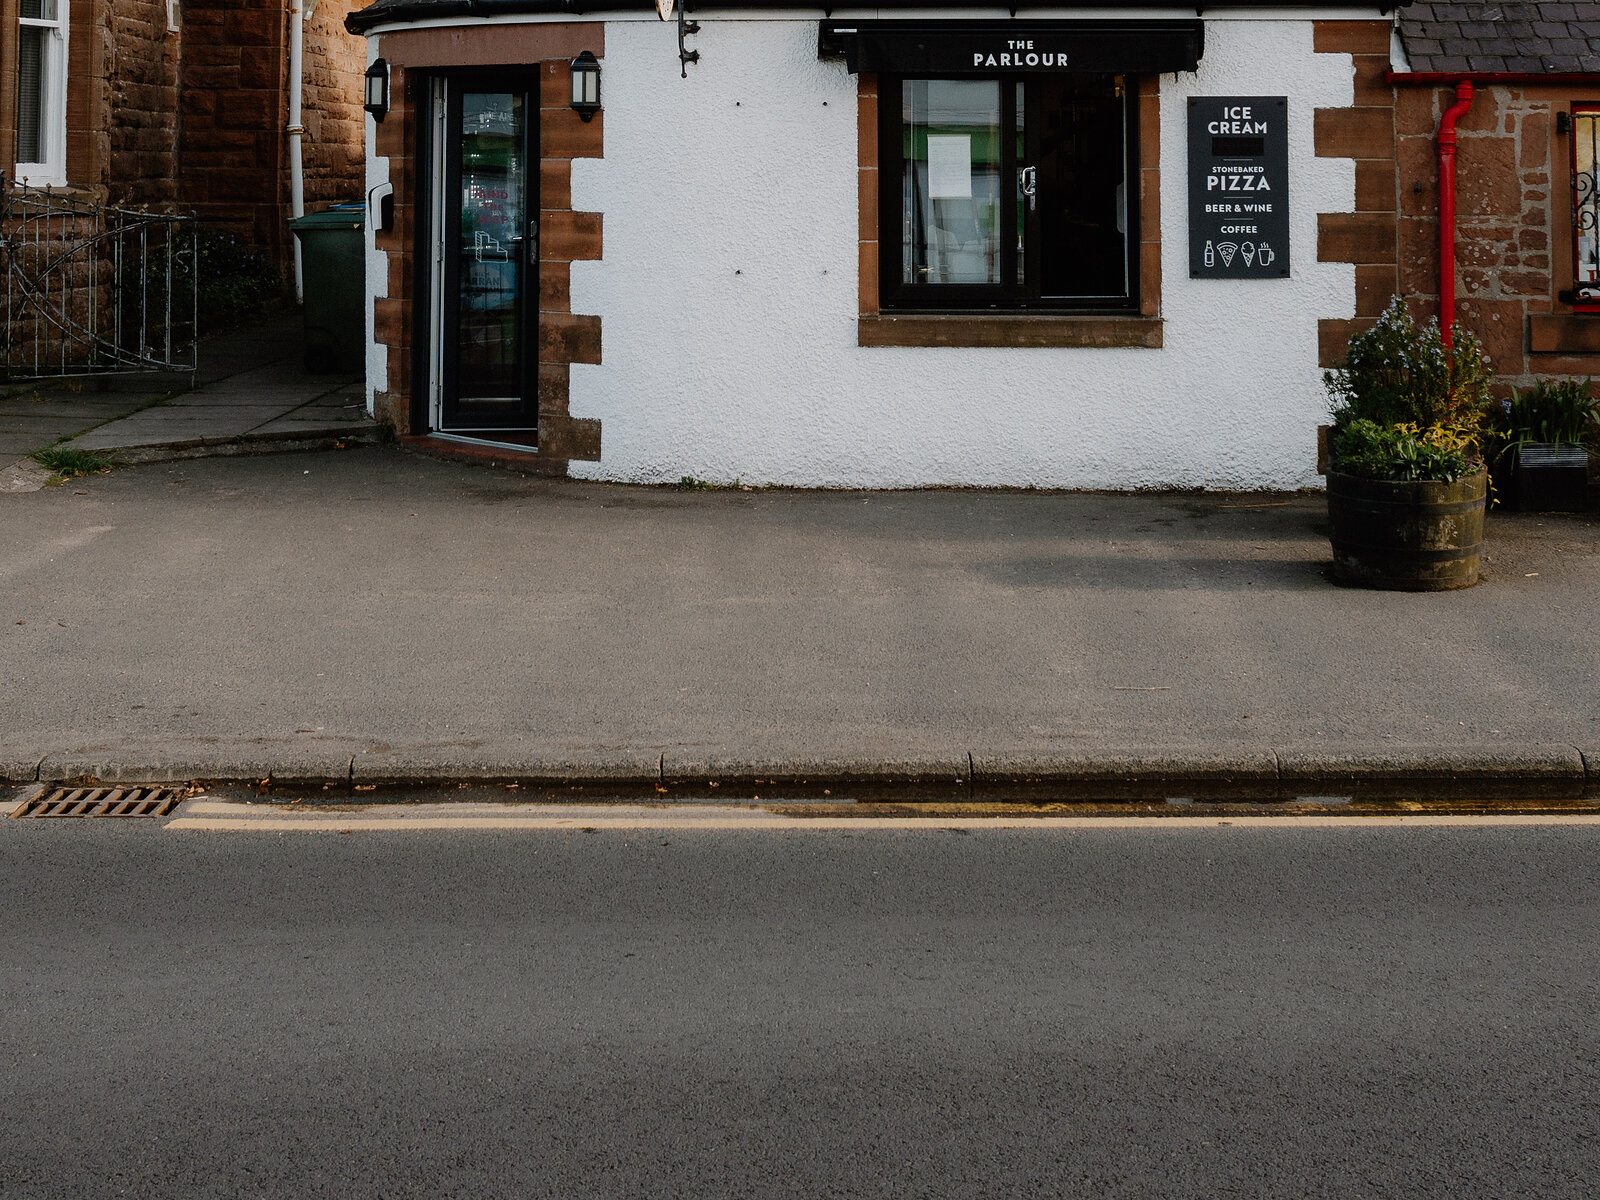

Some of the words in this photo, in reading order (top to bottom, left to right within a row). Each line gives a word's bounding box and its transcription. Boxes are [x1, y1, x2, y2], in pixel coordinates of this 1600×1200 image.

[1007, 40, 1034, 50] THE
[973, 52, 1068, 67] PARLOUR
[1223, 106, 1252, 120] ICE
[1207, 121, 1268, 134] CREAM
[1206, 175, 1271, 191] PIZZA
[1205, 204, 1232, 213] BEER
[1233, 204, 1242, 213] &
[1243, 204, 1273, 213] WINE
[1220, 225, 1258, 234] COFFEE
